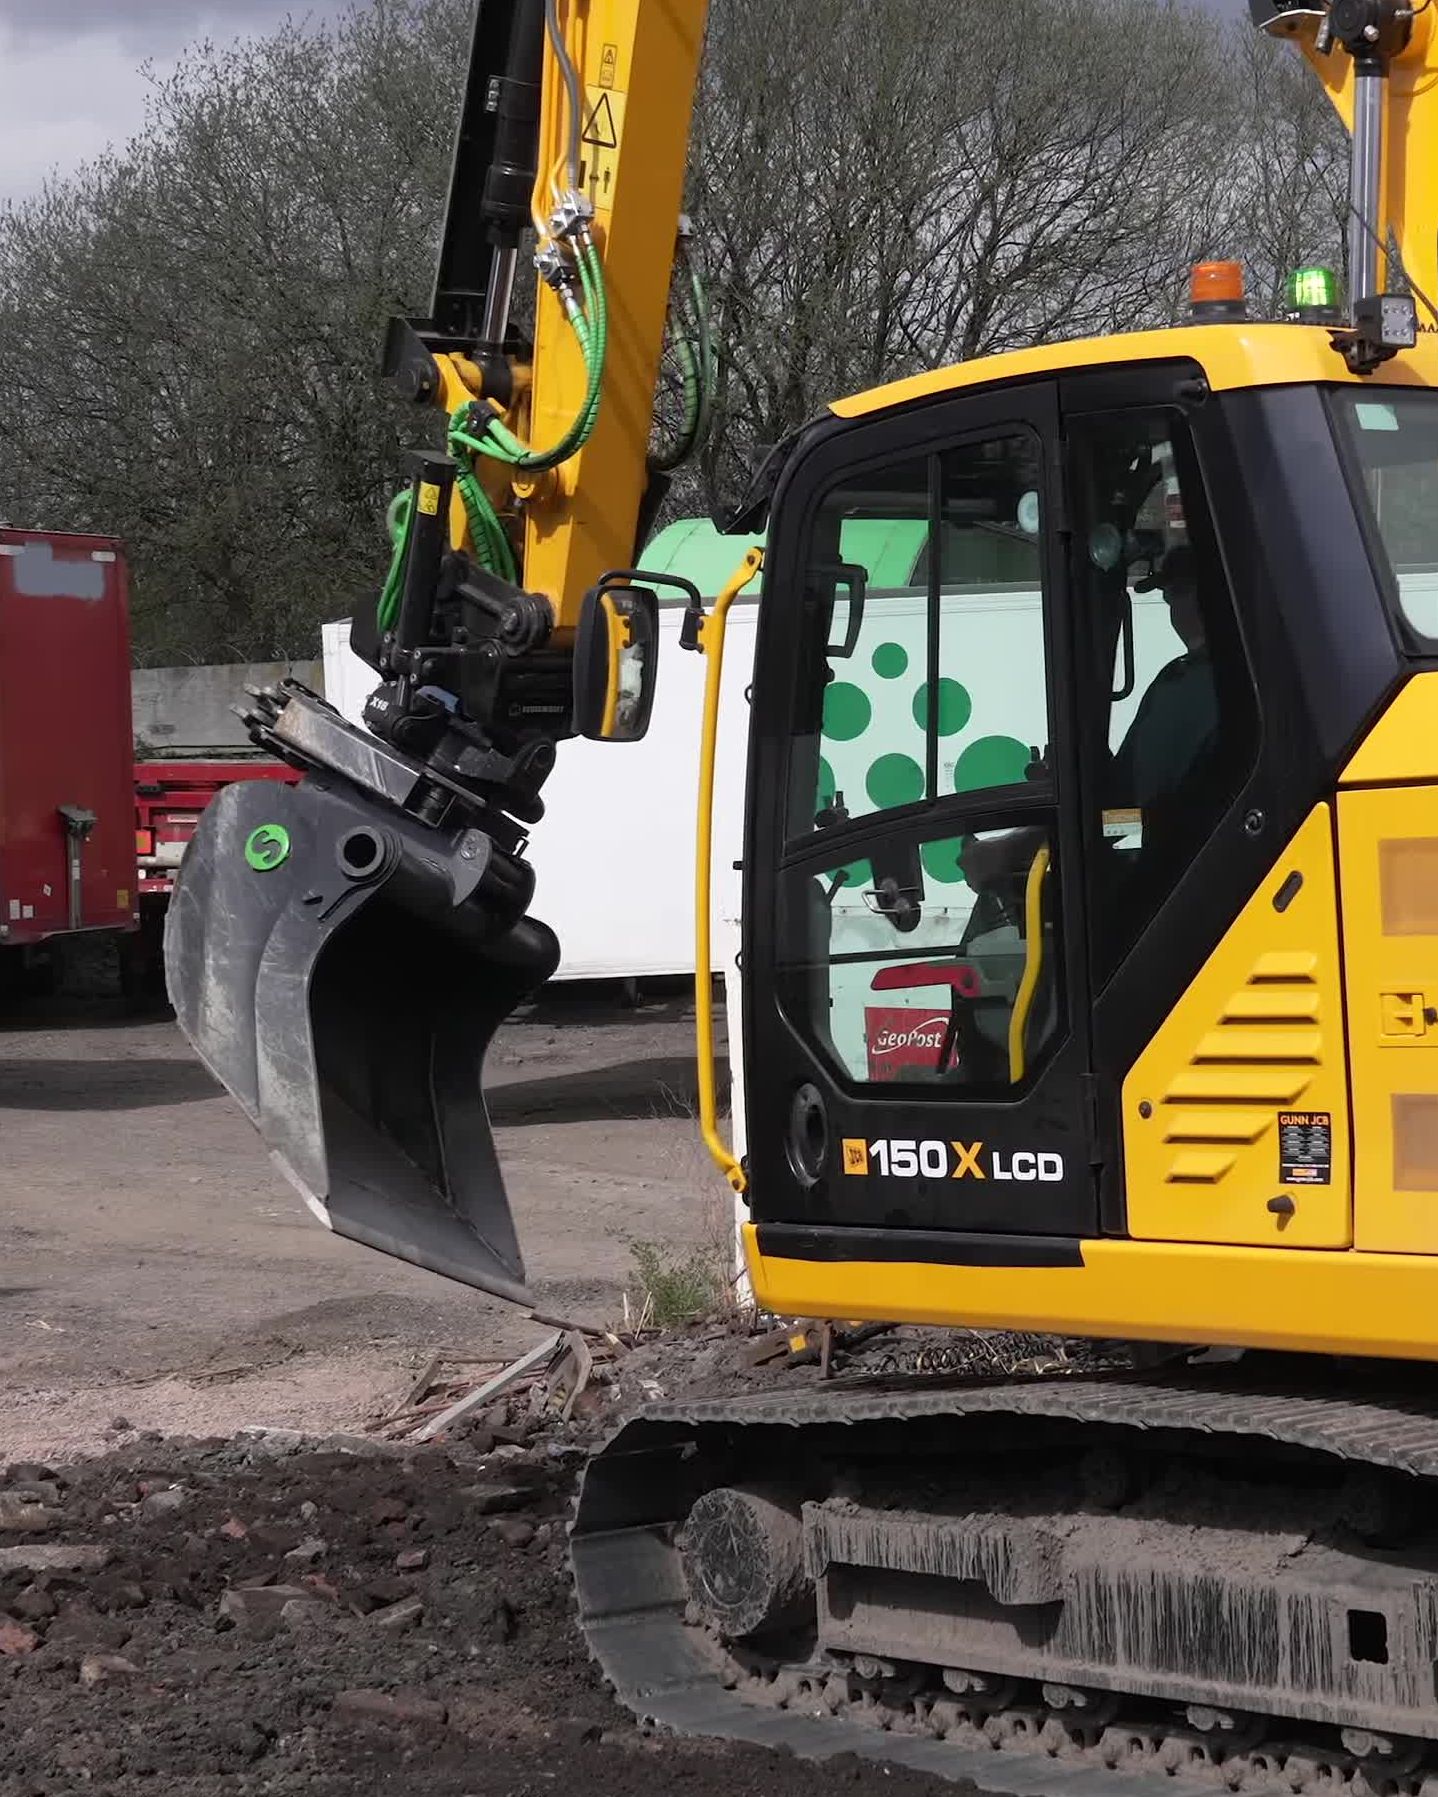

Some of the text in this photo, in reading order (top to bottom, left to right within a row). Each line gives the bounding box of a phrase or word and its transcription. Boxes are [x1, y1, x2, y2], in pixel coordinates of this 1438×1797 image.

[877, 1030, 942, 1048] GeoPost
[1280, 1115, 1330, 1126] GUNN JCB
[992, 1151, 1064, 1181] LCD
